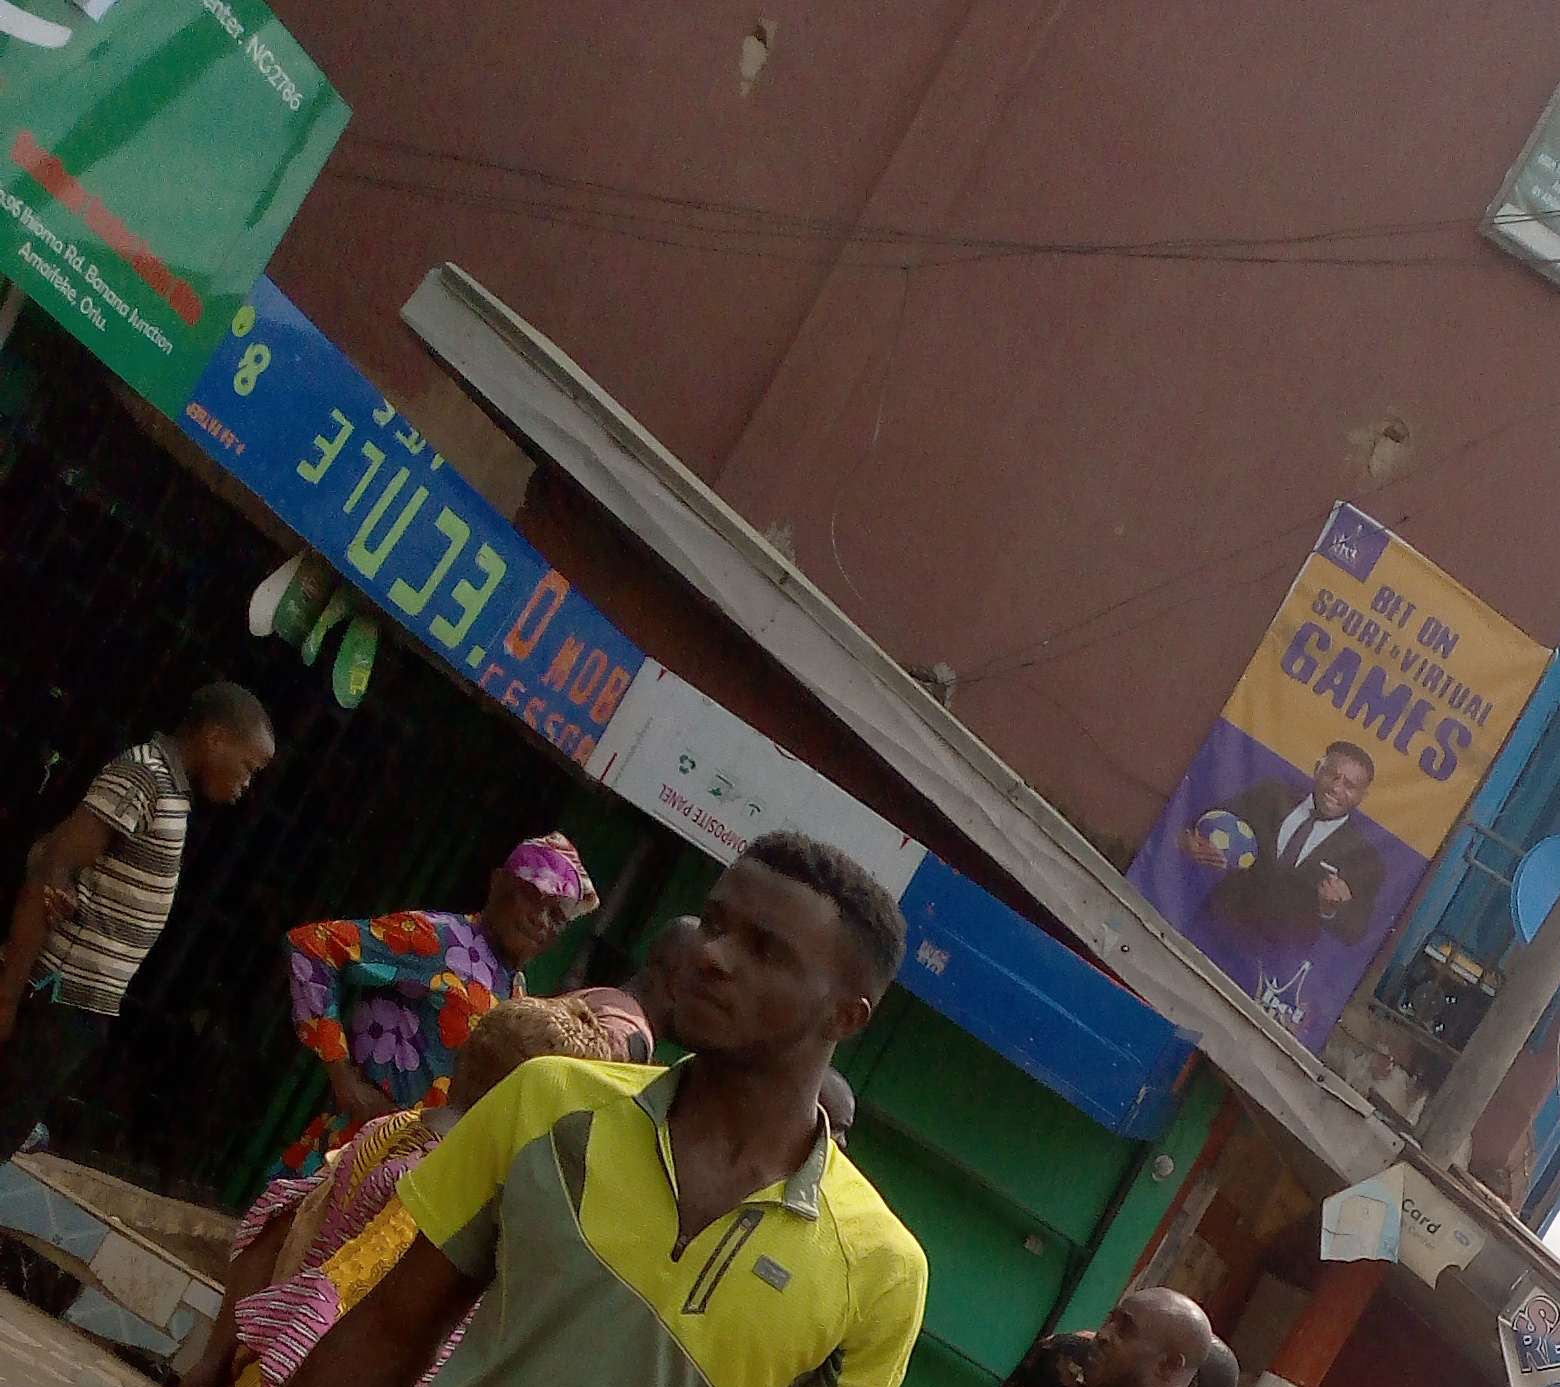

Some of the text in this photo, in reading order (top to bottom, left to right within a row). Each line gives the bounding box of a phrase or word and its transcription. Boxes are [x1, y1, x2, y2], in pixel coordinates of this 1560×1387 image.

[63, 244, 86, 273] Rd.
[85, 264, 131, 318] Banana
[1311, 587, 1392, 655] SPORT
[1400, 647, 1494, 728] VIRTUAL
[1370, 585, 1462, 660] BET ON
[1280, 620, 1473, 782] GAMES
[658, 782, 748, 856] OMPOSITE PANEL
[1401, 1198, 1442, 1235] Card
